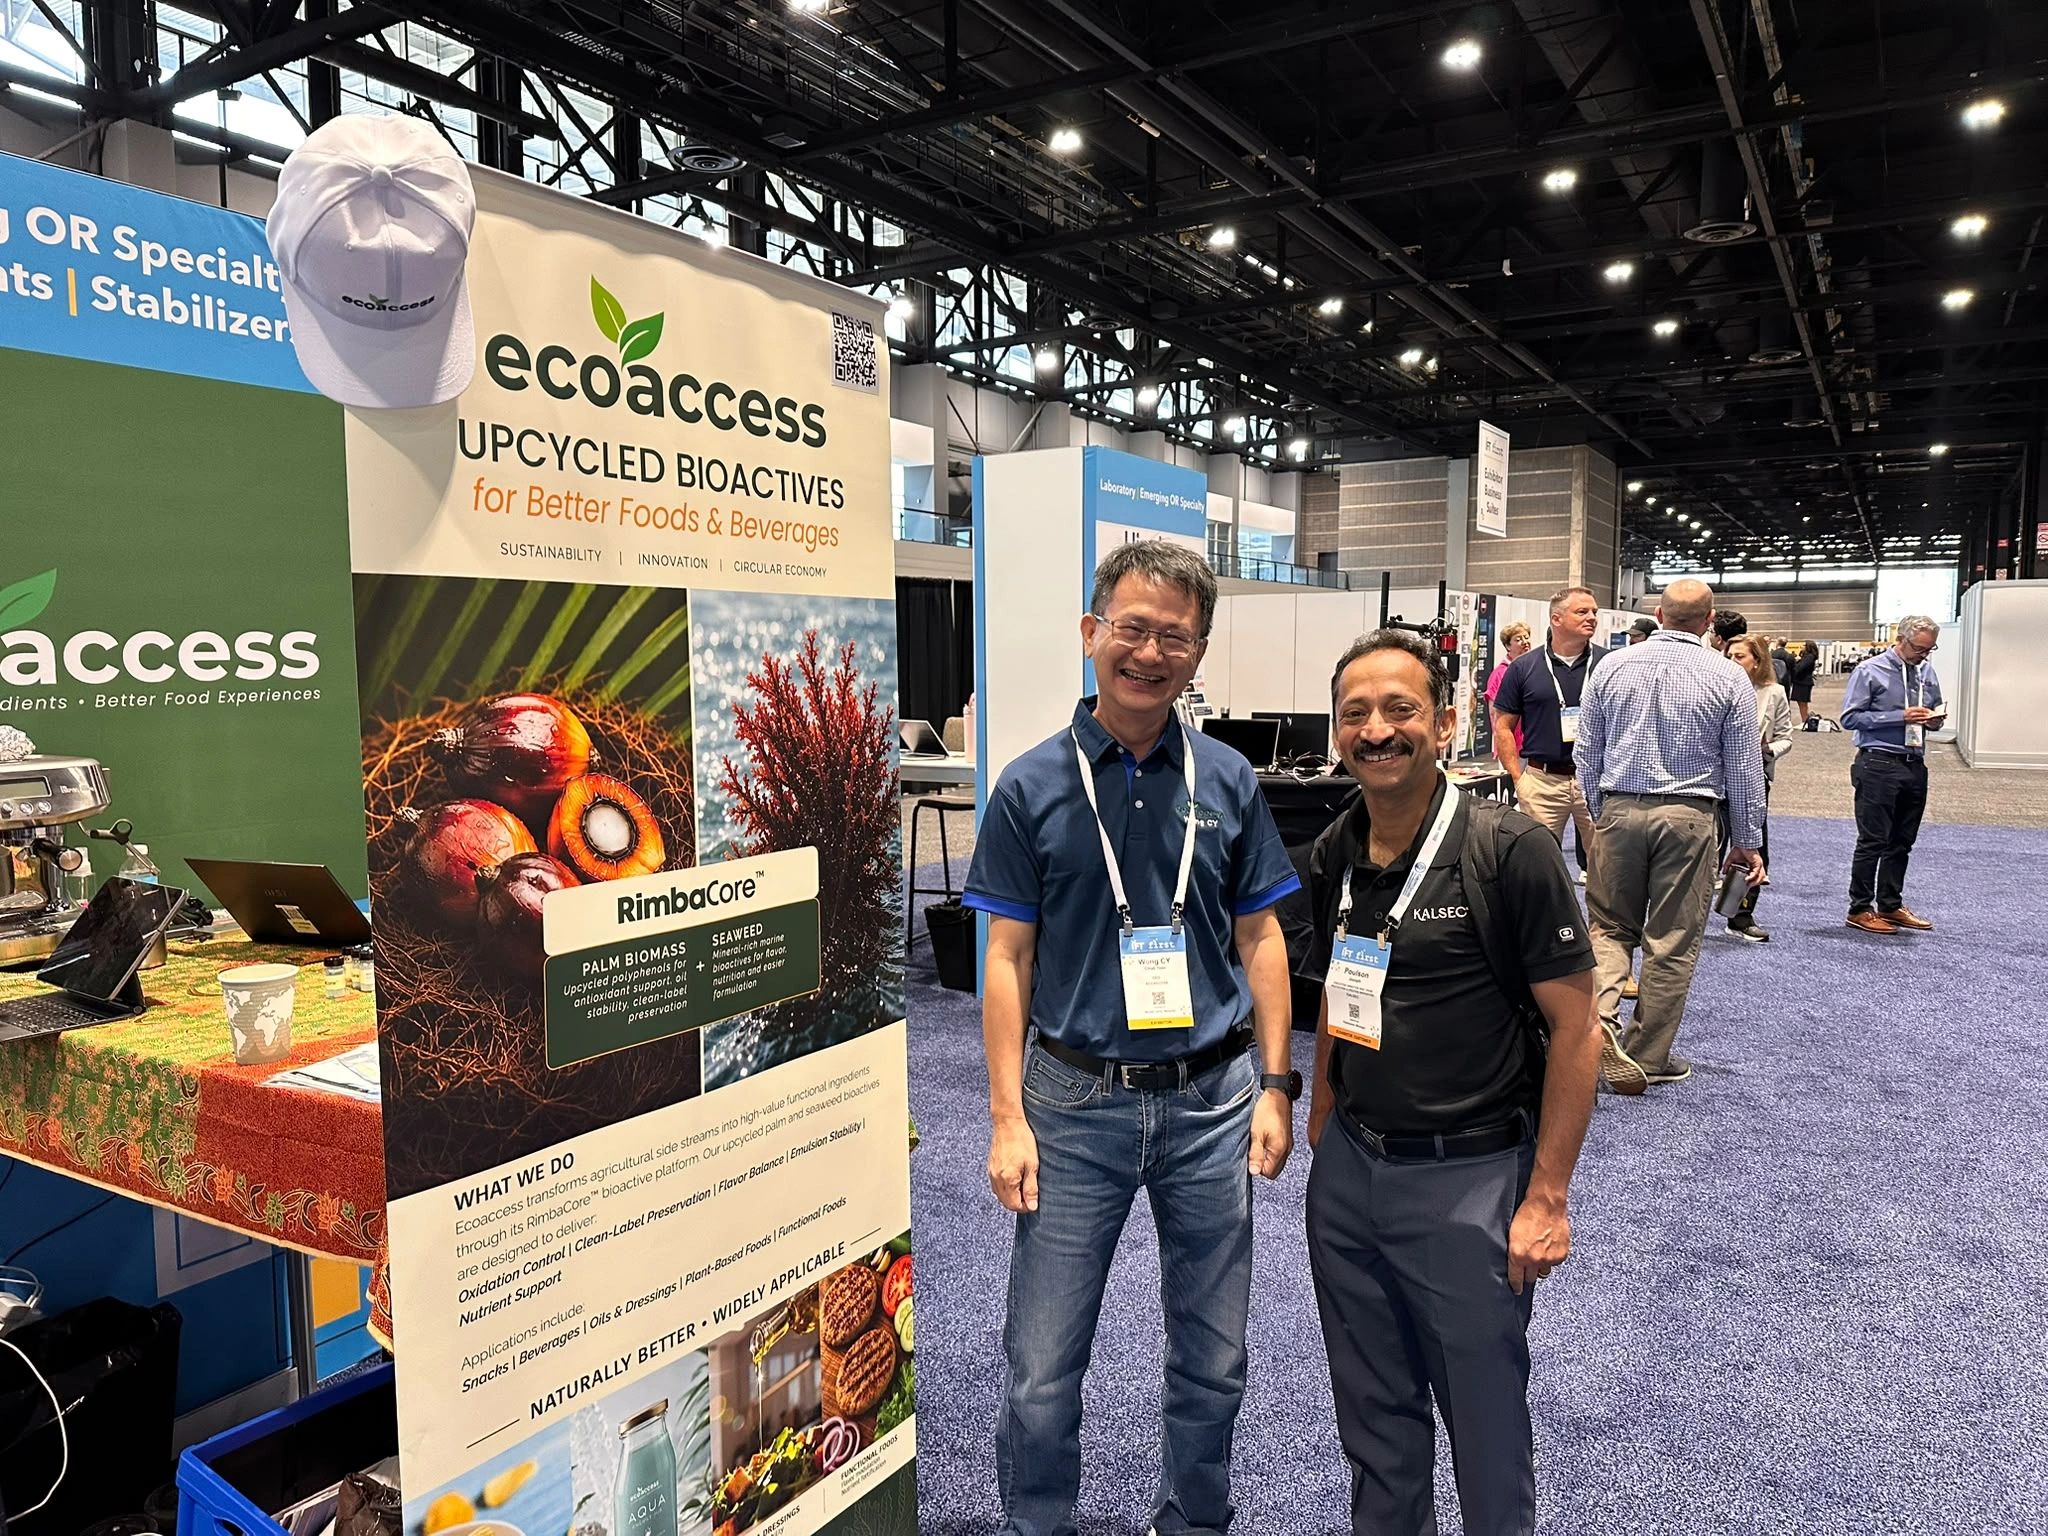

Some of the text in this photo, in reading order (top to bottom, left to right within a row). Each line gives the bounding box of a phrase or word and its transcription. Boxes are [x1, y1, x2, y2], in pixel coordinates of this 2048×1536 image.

[26, 207, 101, 254] OR
[113, 226, 286, 303] Specialt
[91, 276, 294, 345] Stabilizer
[341, 294, 436, 313] ecoaccess
[484, 333, 827, 449] ecoaccess
[458, 418, 845, 510] UPCYCLED BIOACTIVES
[472, 476, 839, 553] for Better Foods & Beverages
[1100, 478, 1205, 514] Laboratory Emerging OR Specialty
[500, 542, 827, 578] SUSTAINABILITY INNOVATION CIRCULAR ECONOMY
[95, 694, 156, 708] Better
[164, 690, 210, 706] Food
[218, 688, 322, 706] Experiences
[712, 923, 763, 946] SEAWEED
[712, 934, 785, 960] Mineral-rich marine
[563, 959, 687, 996] Upcycled polyphenols for
[582, 942, 687, 976] PALM BIOMASS
[712, 955, 752, 973] bioactives
[753, 952, 764, 964] for
[712, 958, 786, 986] nutrition and easier
[1344, 966, 1370, 979] Poulson
[574, 985, 630, 1008] antioxidant
[675, 971, 687, 983] oil
[633, 985, 688, 1007] clean-label
[712, 979, 758, 1002] formulation
[628, 1000, 688, 1025] preservation
[455, 1065, 870, 1235] Ecoaccess transforms agricultural side streams into high-value functional ingredients
[456, 1228, 507, 1258] through
[510, 1223, 524, 1237] its
[602, 1171, 653, 1199] bioactive
[702, 1144, 721, 1160] Our
[722, 1125, 764, 1153] upcycled
[765, 1116, 787, 1136] palm
[788, 1110, 804, 1124] and
[805, 1093, 842, 1117] seaweed
[843, 1078, 880, 1102] bioactives
[454, 1152, 575, 1211] WHAT WE DO
[458, 1120, 862, 1304] Oxidation Control Clean-Label Preservation Flavor Balance Emulsion Stability
[456, 1214, 598, 1282] are designed to deliver:
[458, 1270, 562, 1328] Nutrient Support
[461, 1196, 847, 1393] Snacks Beverages Oils & Dressings Plant-Based Foods Functional Foods
[461, 1302, 586, 1371] Applications include:
[530, 1240, 846, 1420] NATURALLY BETTER WIDELY APPLICABLE
[841, 1434, 898, 1480] FUNCTIONAL FOODS
[628, 1494, 666, 1524] AQUA
[762, 1505, 800, 1536] DRESSINGS
